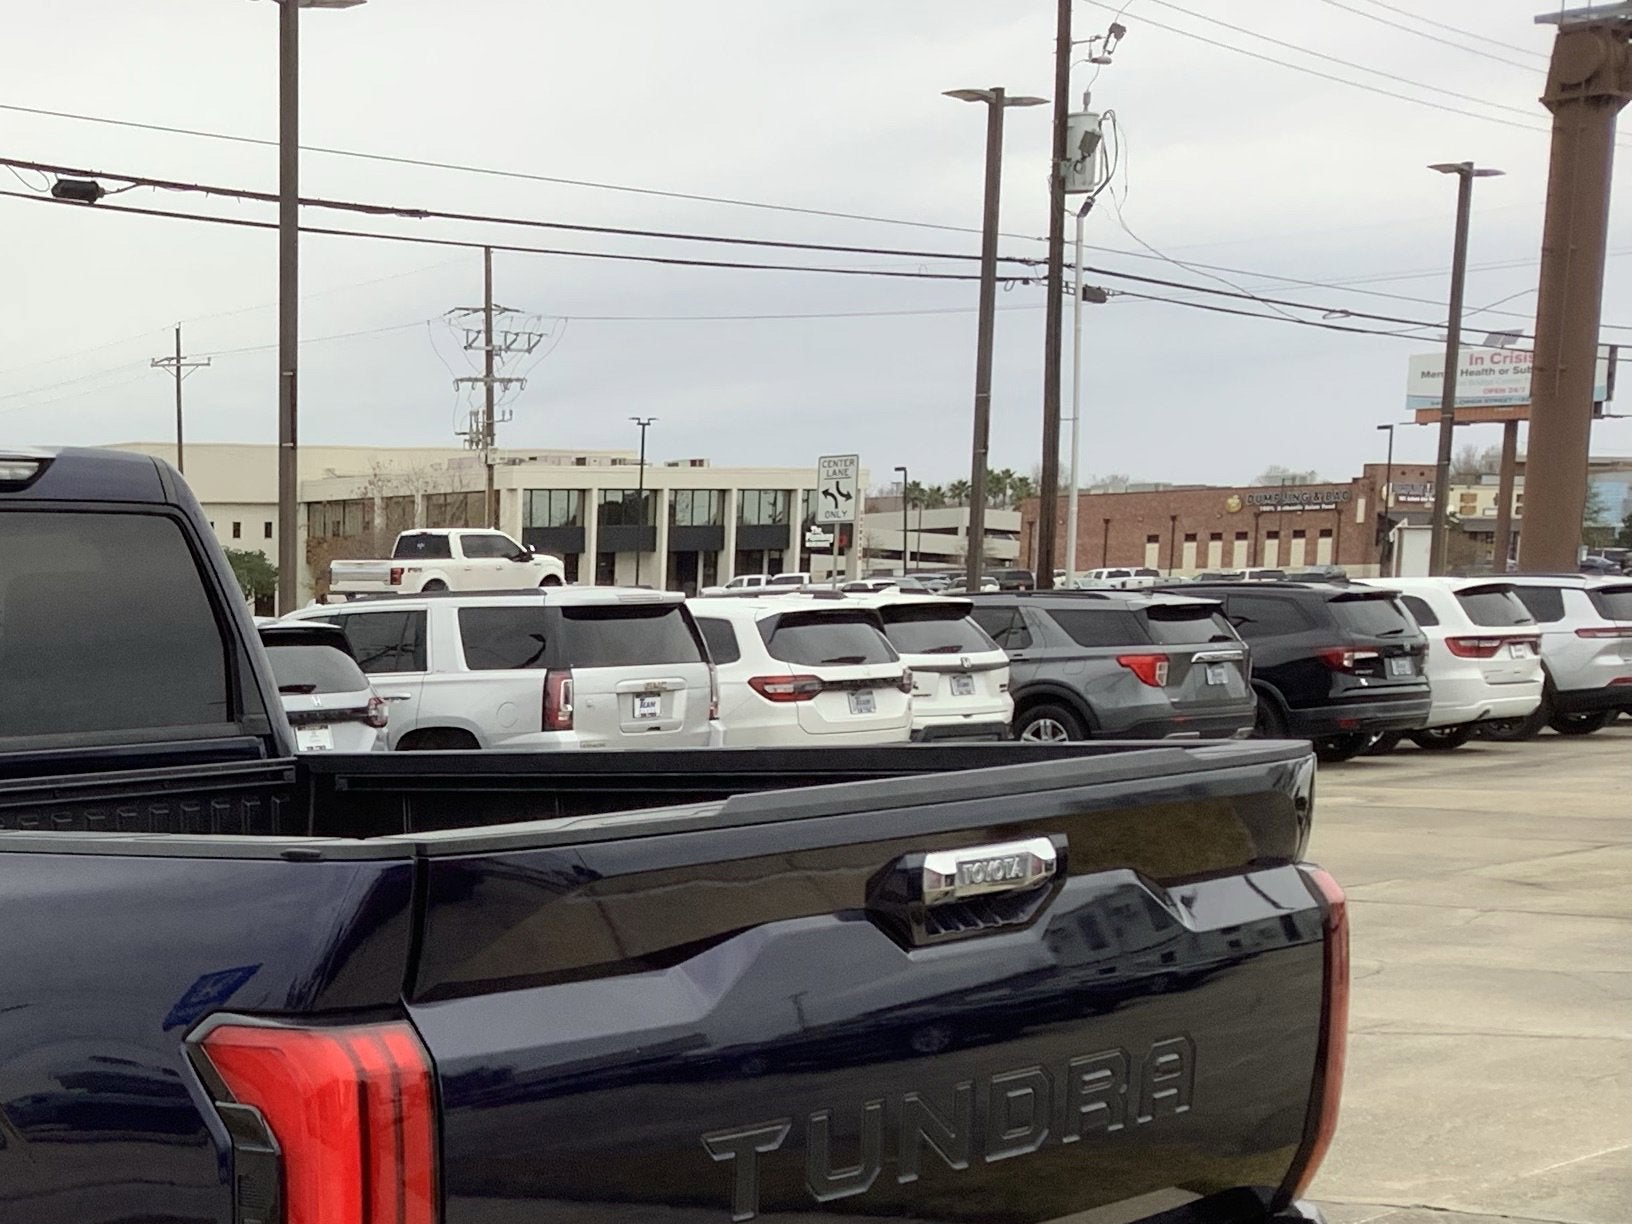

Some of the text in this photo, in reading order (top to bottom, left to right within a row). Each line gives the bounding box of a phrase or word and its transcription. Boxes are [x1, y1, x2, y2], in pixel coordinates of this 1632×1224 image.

[1469, 353, 1485, 366] In
[1460, 367, 1497, 377] Health
[822, 459, 855, 468] CENTER
[826, 468, 849, 477] LANE
[1312, 491, 1321, 502] &
[824, 510, 848, 519] ONLY
[962, 857, 1024, 885] TOYOTA
[701, 1030, 1197, 1222] TUNDRA
